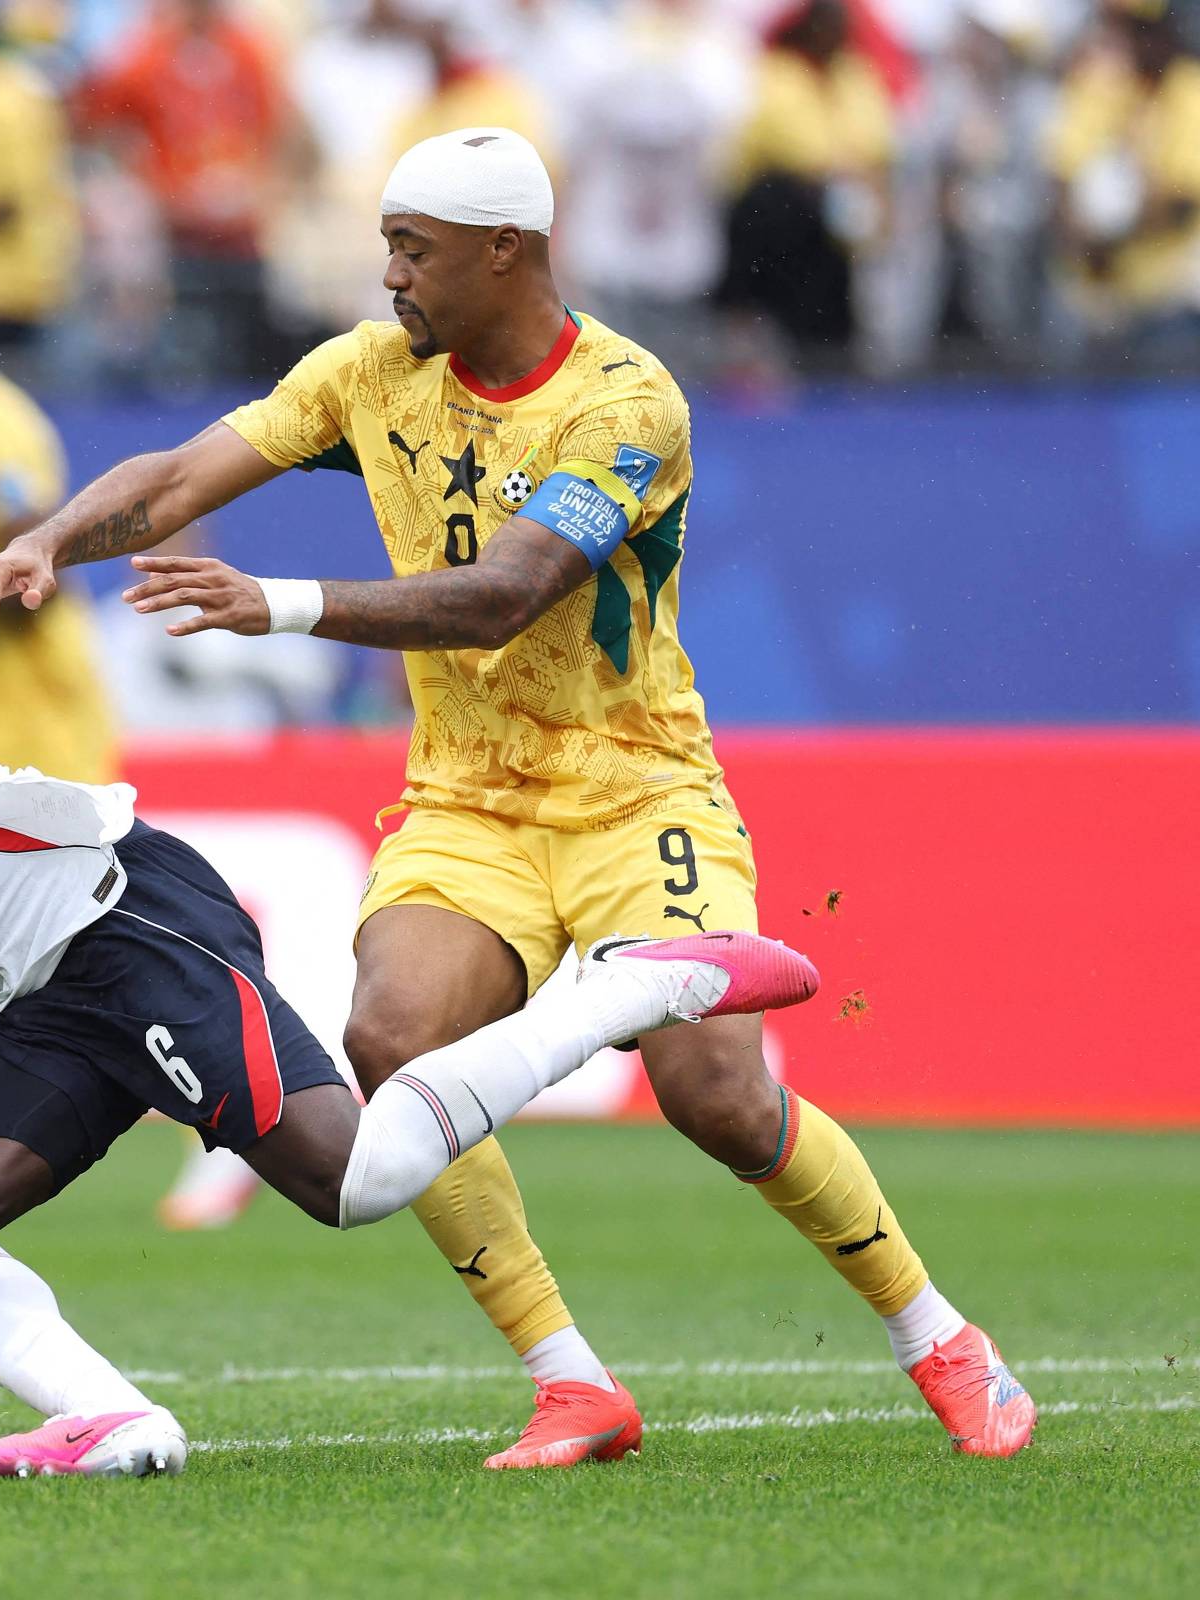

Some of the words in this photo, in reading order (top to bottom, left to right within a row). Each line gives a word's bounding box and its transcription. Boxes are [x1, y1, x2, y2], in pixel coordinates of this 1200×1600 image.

[547, 501, 570, 518] the
[570, 513, 609, 547] World
[559, 489, 615, 535] UNITES
[566, 480, 619, 525] FOOTBALL
[557, 521, 583, 540] FIFA
[657, 827, 699, 896] 9
[145, 1023, 204, 1105] 6
